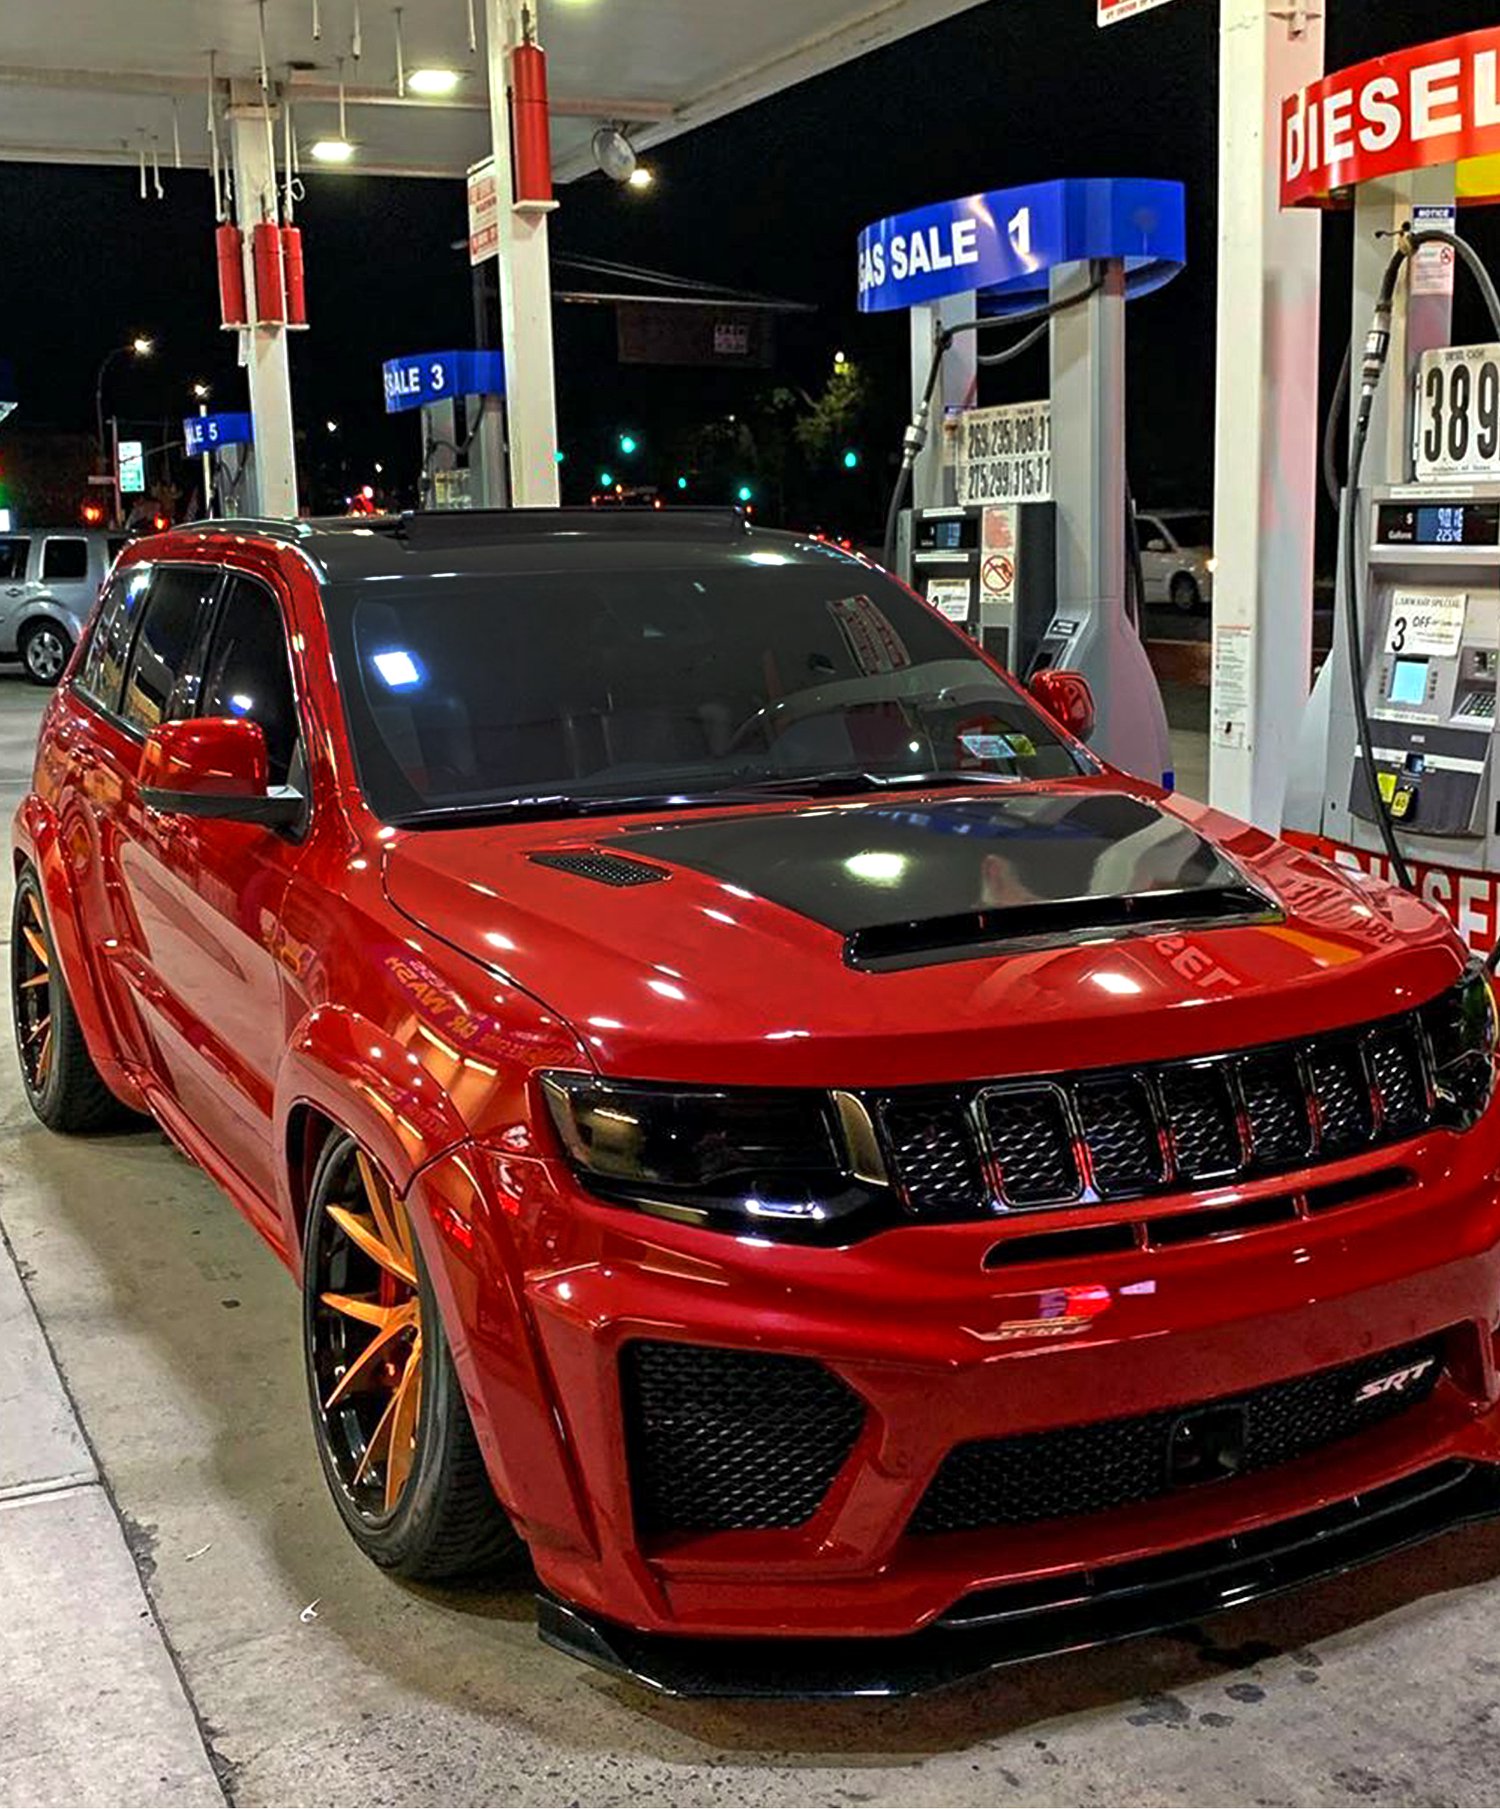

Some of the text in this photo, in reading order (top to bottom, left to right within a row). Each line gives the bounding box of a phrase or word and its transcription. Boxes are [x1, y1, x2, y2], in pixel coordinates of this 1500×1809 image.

[1287, 50, 1500, 183] DIESEL
[891, 219, 979, 280] SALE
[1008, 207, 1030, 253] 1
[431, 363, 445, 390] 3
[208, 422, 218, 441] 5
[1391, 616, 1408, 652] 3
[1355, 1358, 1436, 1402] SRT
